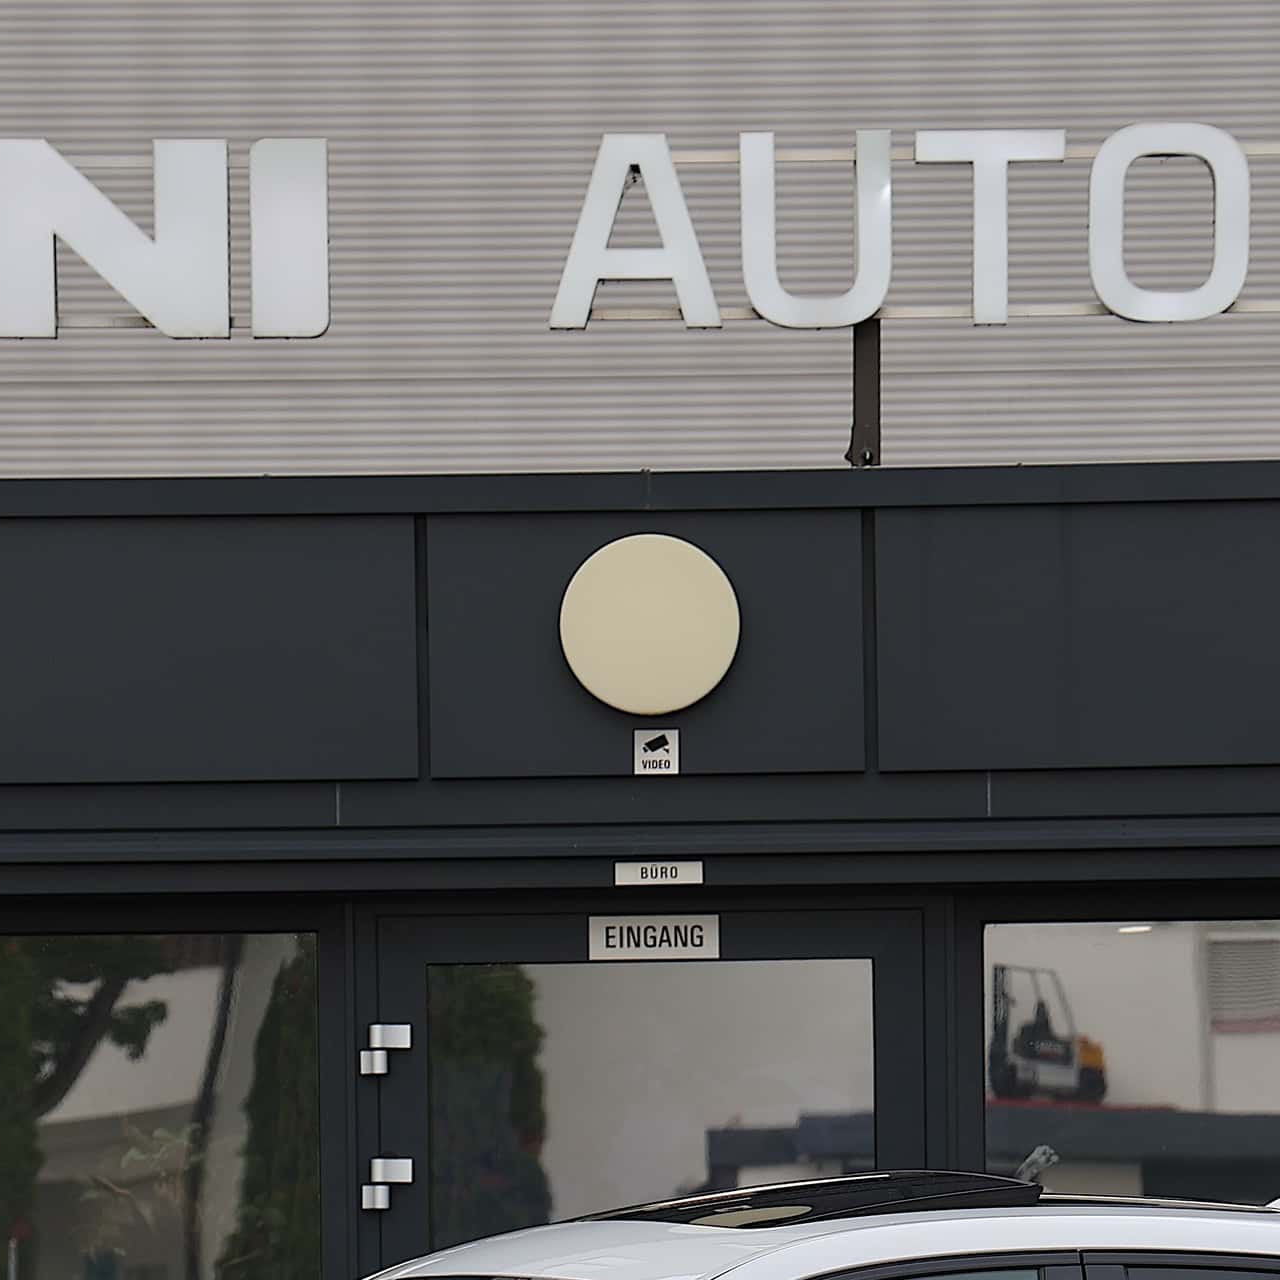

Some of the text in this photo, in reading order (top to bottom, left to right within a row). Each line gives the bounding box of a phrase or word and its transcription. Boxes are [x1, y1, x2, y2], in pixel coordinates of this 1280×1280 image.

[549, 121, 1251, 330] AUTO
[641, 759, 671, 770] VIDEO
[640, 863, 679, 880] BÜRO
[604, 924, 705, 949] EINGANG
